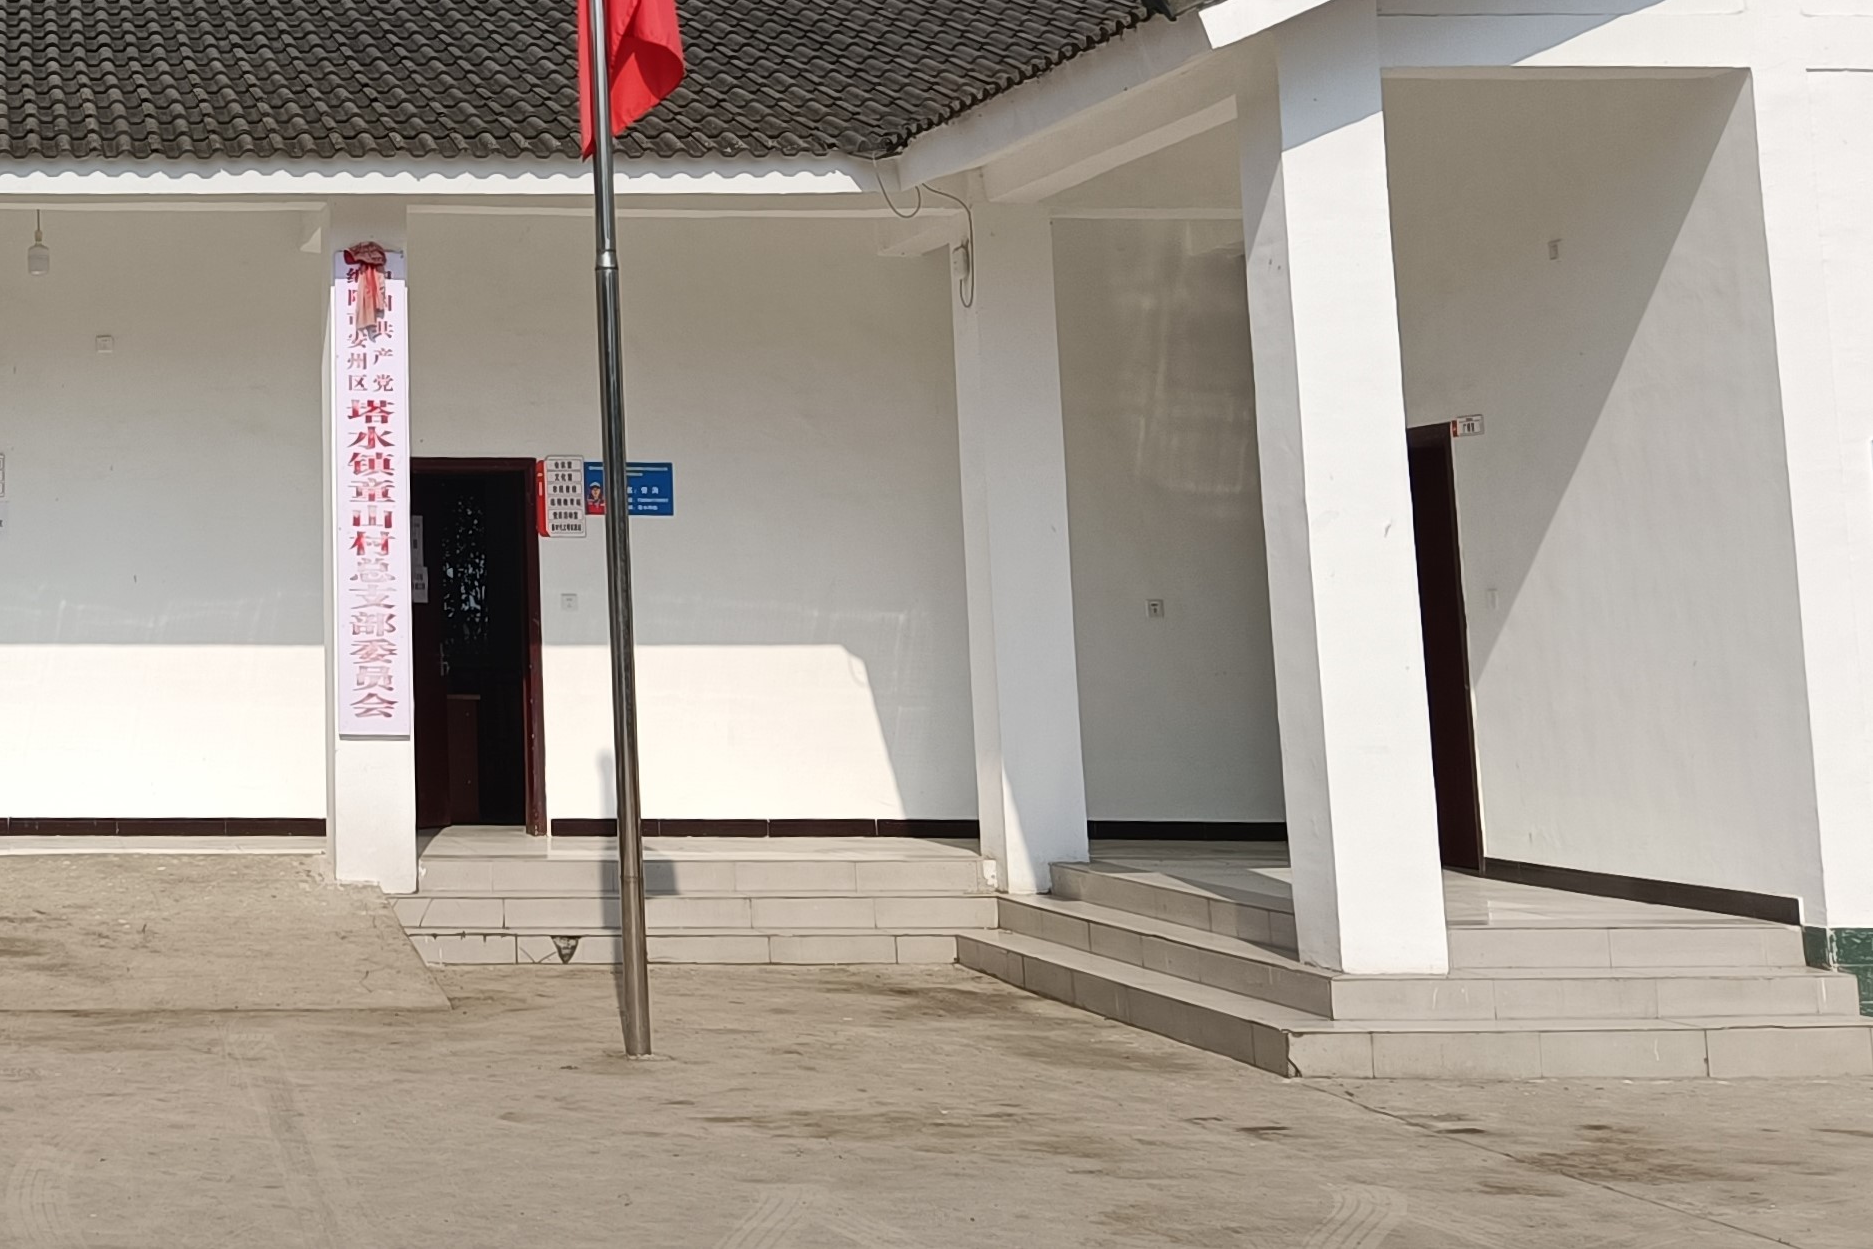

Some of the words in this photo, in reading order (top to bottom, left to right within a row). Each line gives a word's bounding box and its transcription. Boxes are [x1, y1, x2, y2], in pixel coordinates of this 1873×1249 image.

[346, 399, 399, 719] 塔水镇童山村总支部委员会
